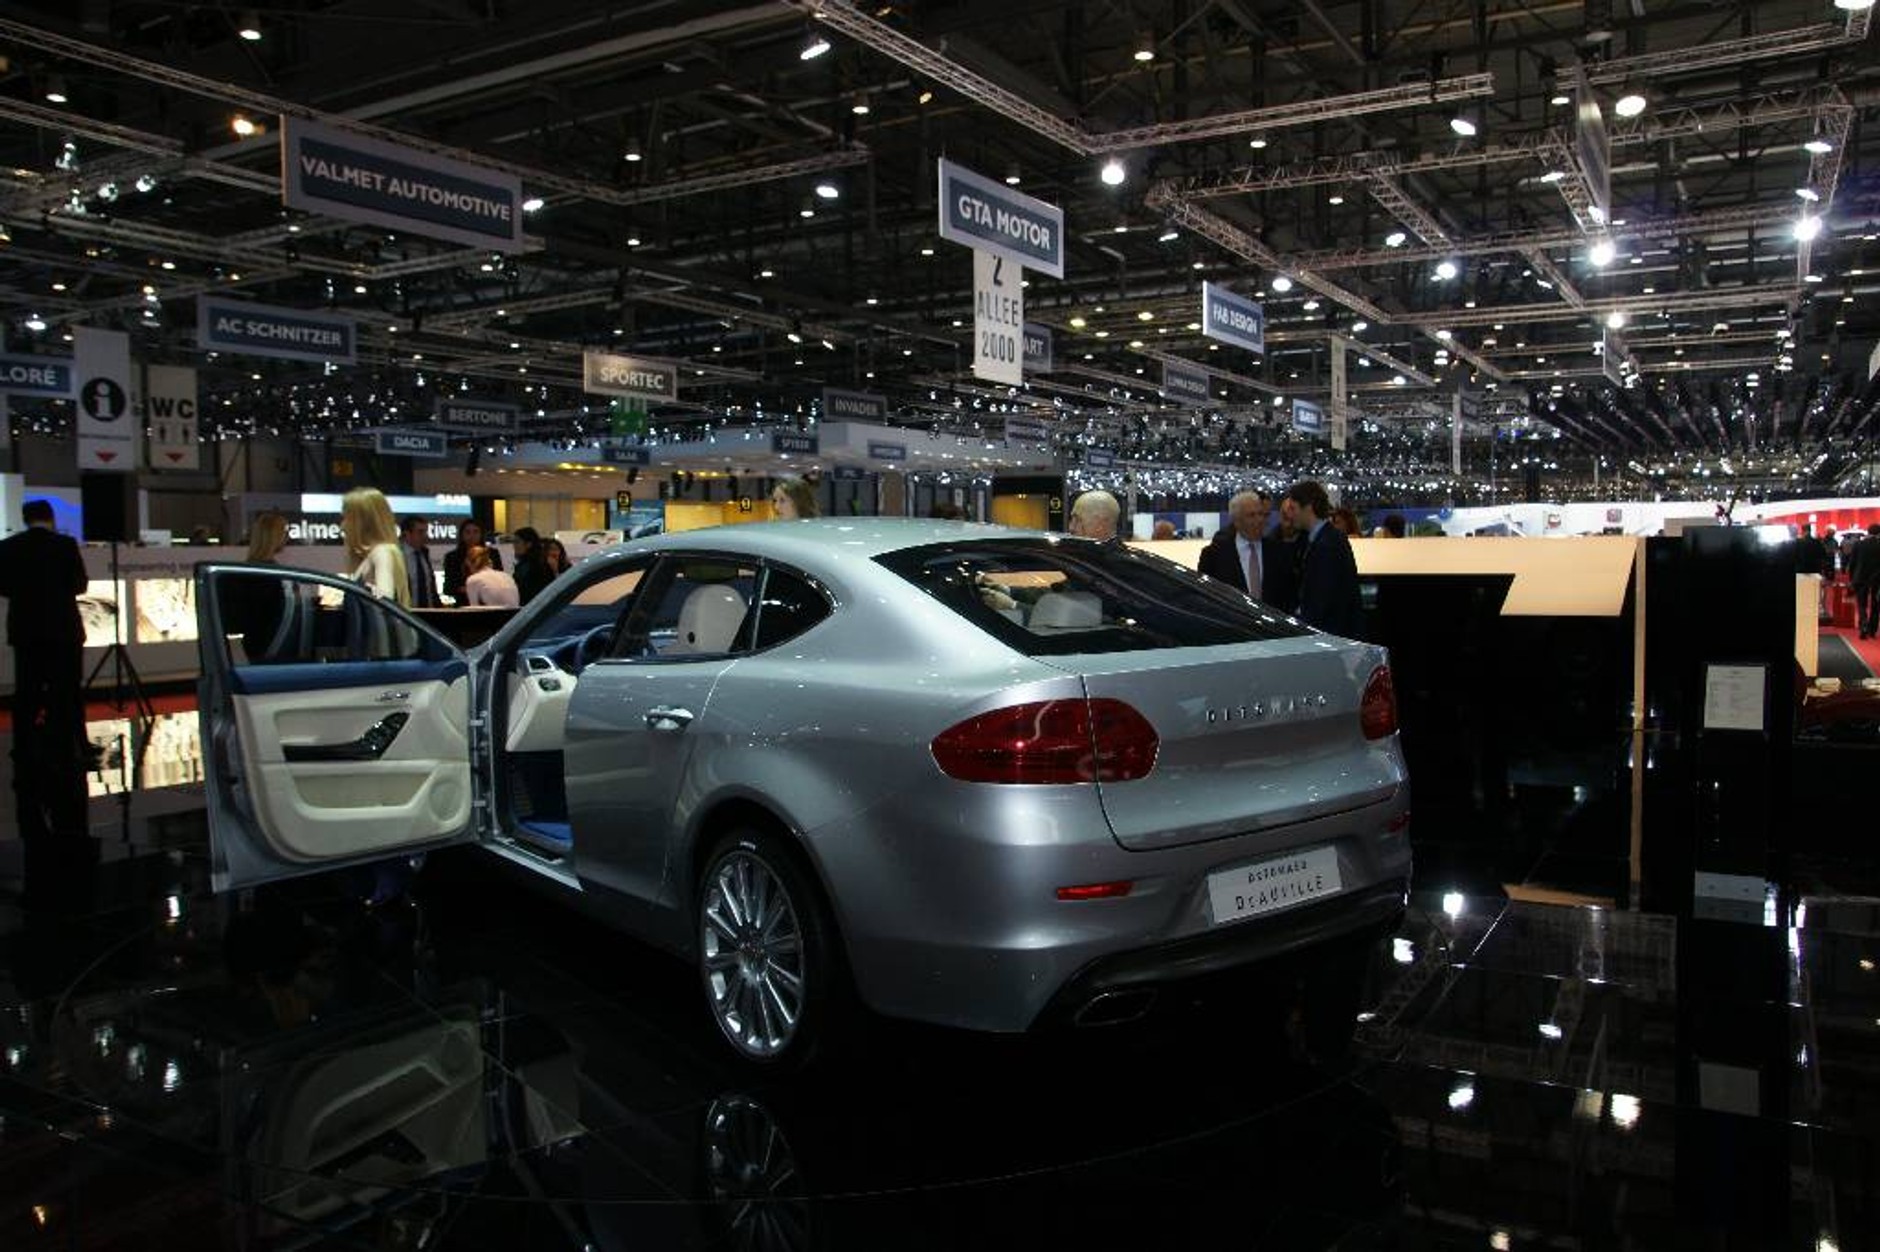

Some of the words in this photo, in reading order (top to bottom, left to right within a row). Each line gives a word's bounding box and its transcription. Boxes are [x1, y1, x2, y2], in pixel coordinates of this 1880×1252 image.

[301, 155, 385, 191] VALMET
[388, 178, 511, 222] AUTOMOTIVE
[958, 195, 993, 229] GTA
[997, 209, 1051, 250] MOTOR
[977, 291, 1019, 327] ALLEE
[217, 316, 241, 334] AC
[247, 321, 342, 347] SCHNITZER
[981, 330, 1015, 364] 2000
[600, 367, 664, 389] SPORTEC
[152, 397, 195, 420] WC
[393, 436, 430, 450] DACIA
